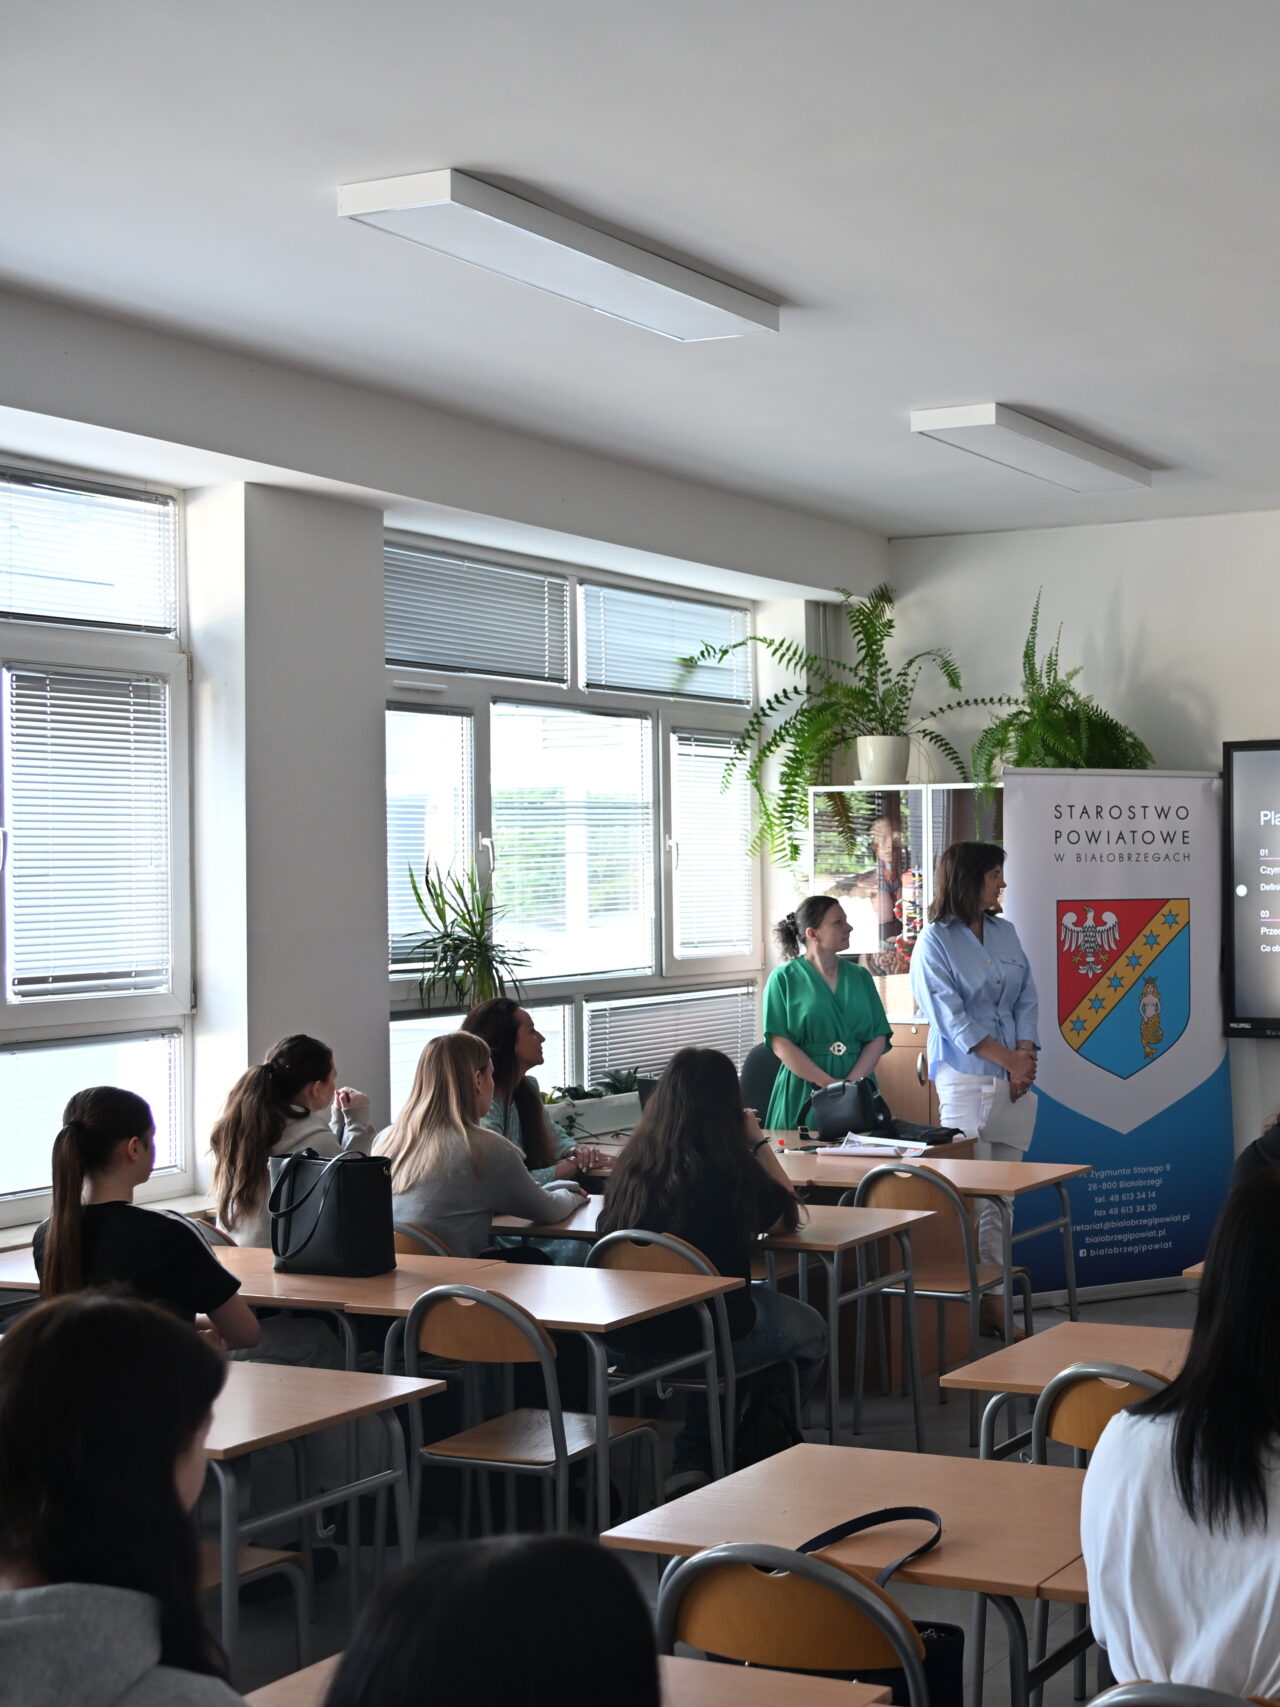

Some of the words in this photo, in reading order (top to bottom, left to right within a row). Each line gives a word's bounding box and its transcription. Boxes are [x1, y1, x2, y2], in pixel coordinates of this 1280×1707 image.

[1054, 804, 1189, 820] STAROSTWO
[1054, 830, 1190, 845] POWIATOWE
[1054, 853, 1065, 862] W
[1076, 852, 1190, 863] BIAŁOBRZEGACH
[1260, 849, 1269, 857] 01
[1090, 1168, 1131, 1179] Zygmunta
[1133, 1165, 1164, 1175] Starego
[1121, 1193, 1133, 1201] 613
[1135, 1192, 1146, 1200] 34
[1147, 1191, 1156, 1199] 14
[1094, 1208, 1106, 1217] fax
[1109, 1207, 1119, 1215] 48
[1121, 1206, 1133, 1214] 613
[1135, 1205, 1145, 1213] 34
[1147, 1204, 1157, 1212] 20
